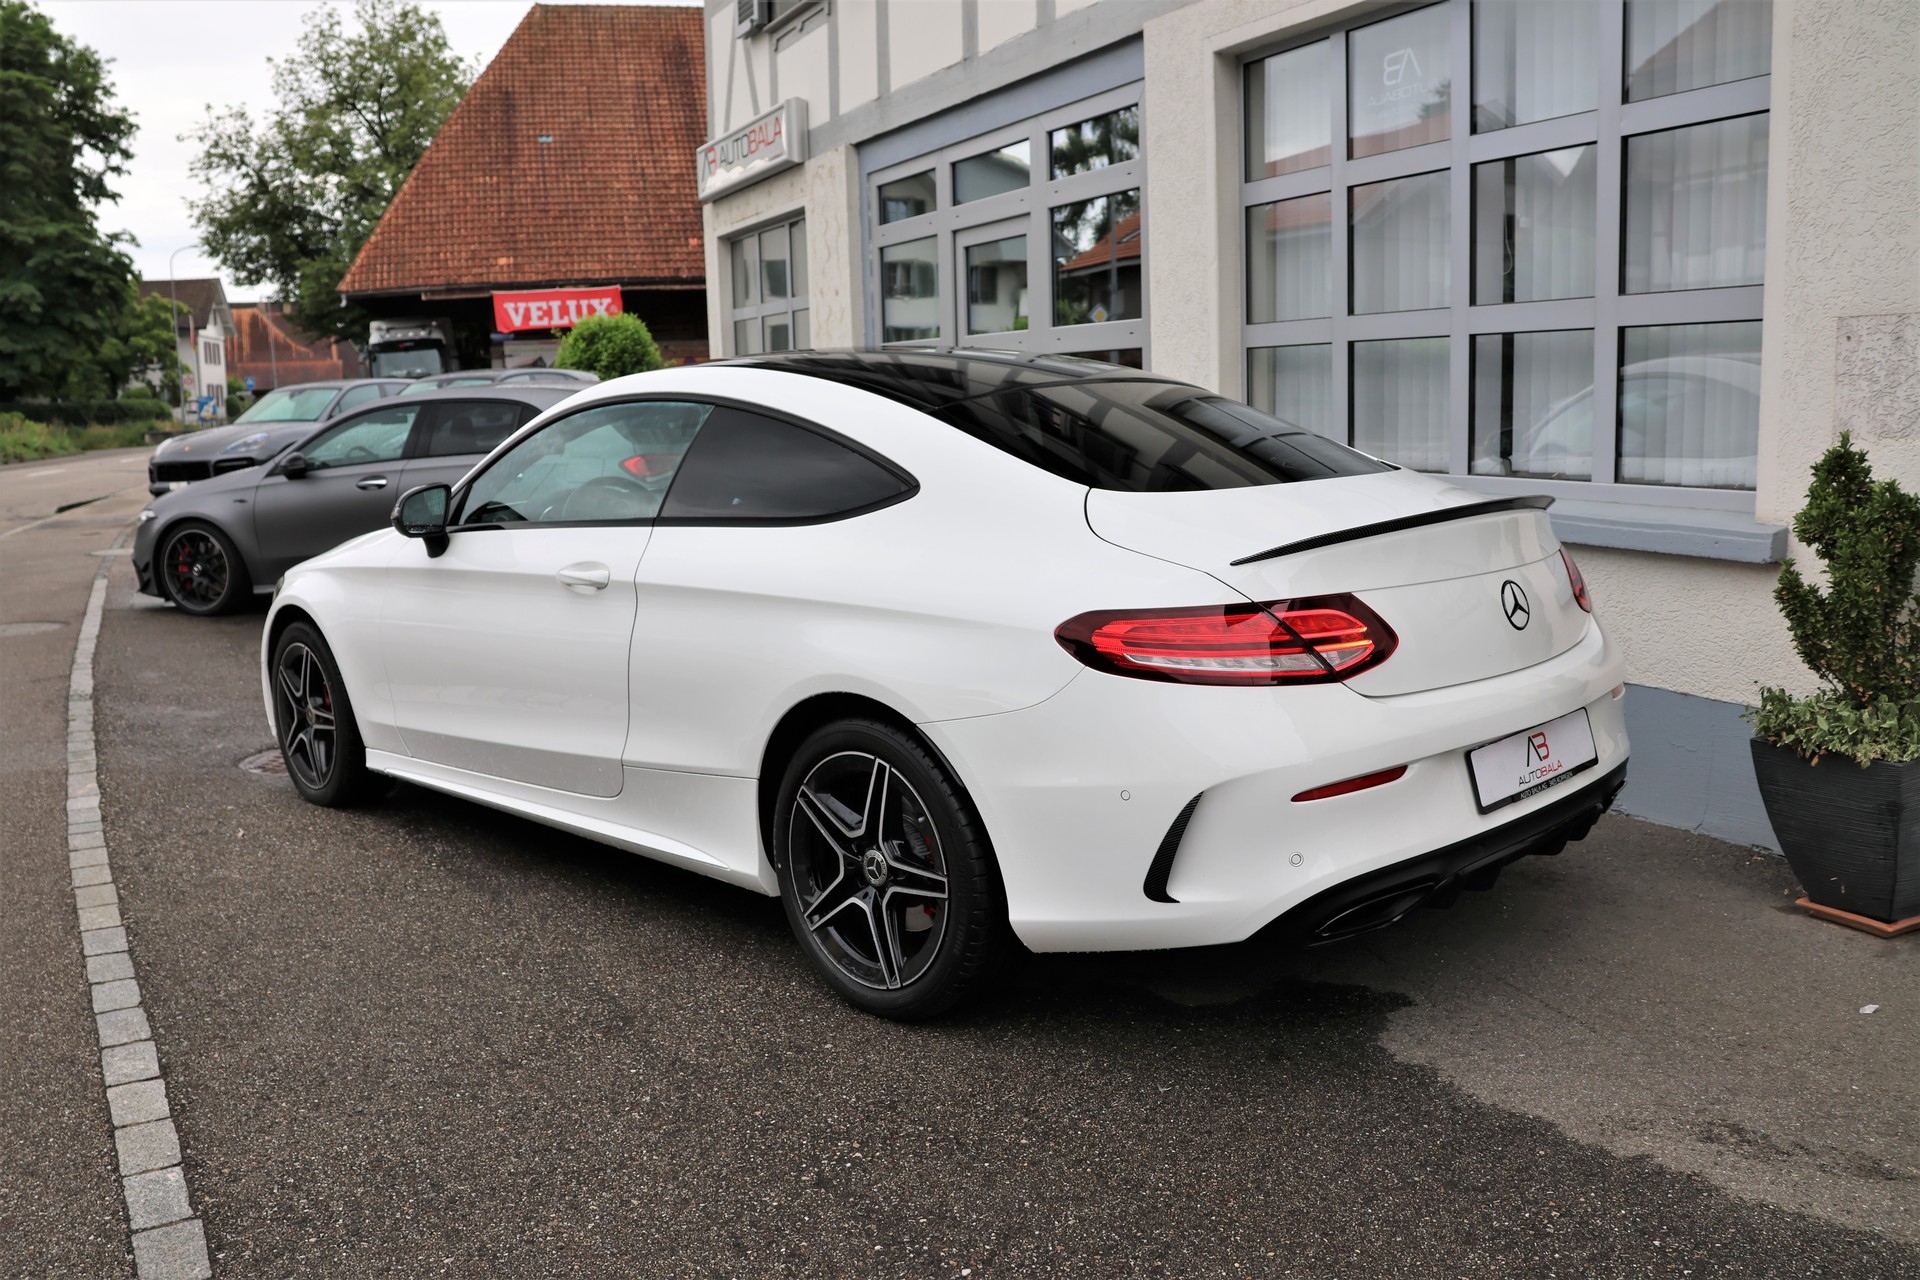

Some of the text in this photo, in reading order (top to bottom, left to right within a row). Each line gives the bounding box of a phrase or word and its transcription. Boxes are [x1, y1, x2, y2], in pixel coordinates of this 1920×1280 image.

[719, 115, 782, 165] AUTOBALA
[503, 297, 612, 327] VELUX
[1518, 760, 1563, 786] AUTOBALA
